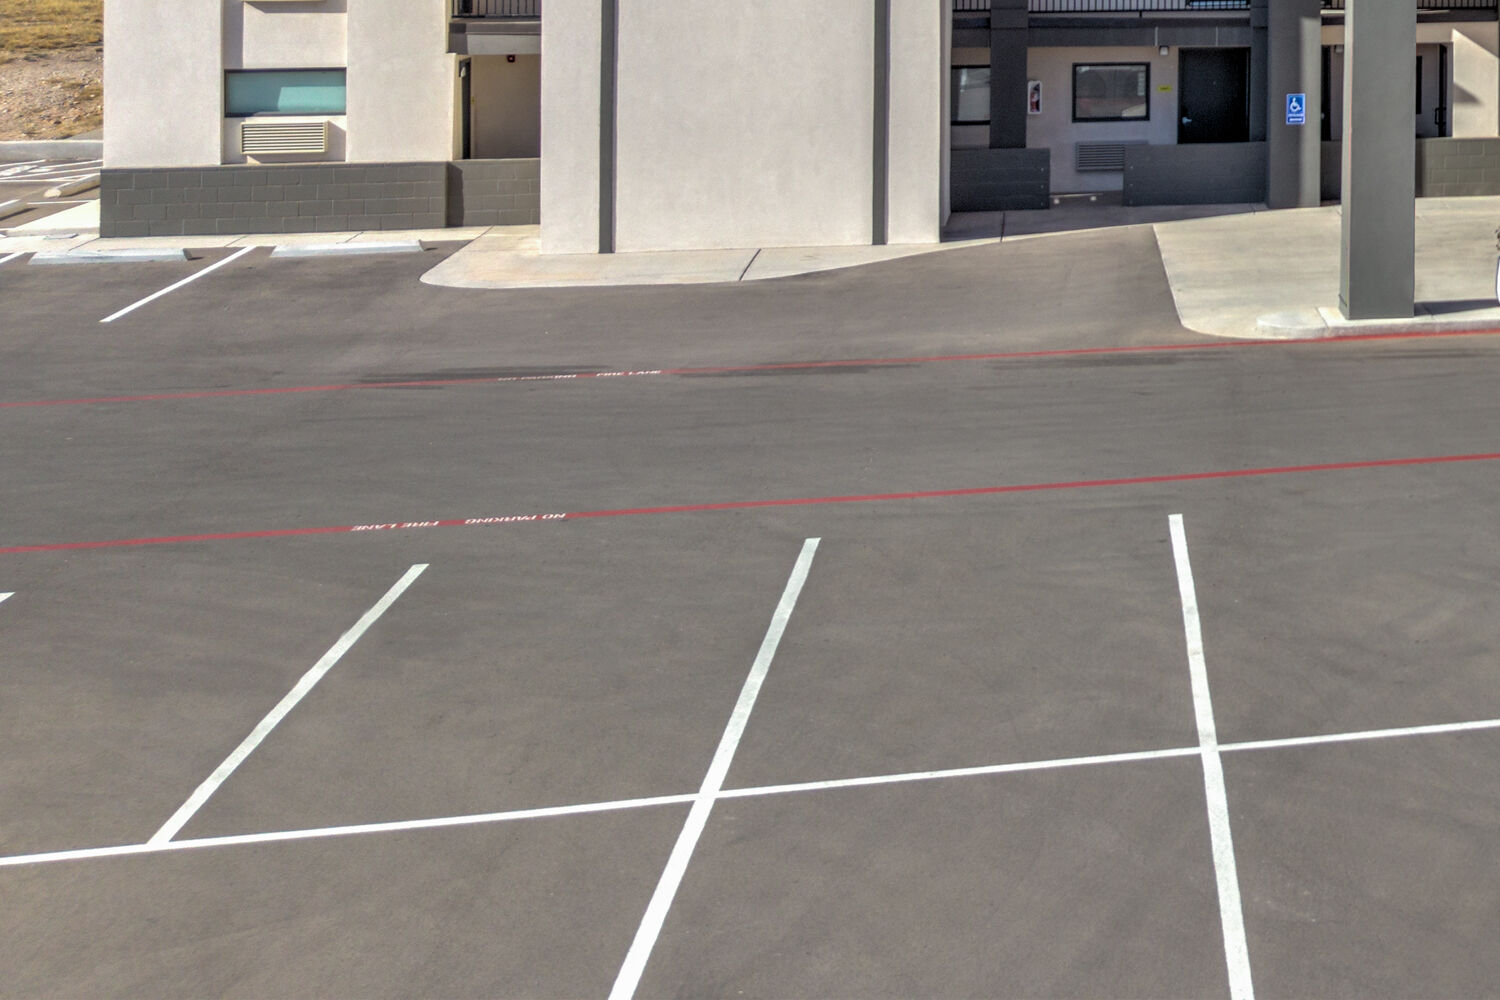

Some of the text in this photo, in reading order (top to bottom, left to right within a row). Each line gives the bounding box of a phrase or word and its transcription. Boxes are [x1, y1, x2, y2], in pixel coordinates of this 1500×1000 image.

[401, 520, 441, 529] FIRE
[464, 514, 538, 525] PARKING
[350, 522, 397, 532] LANE
